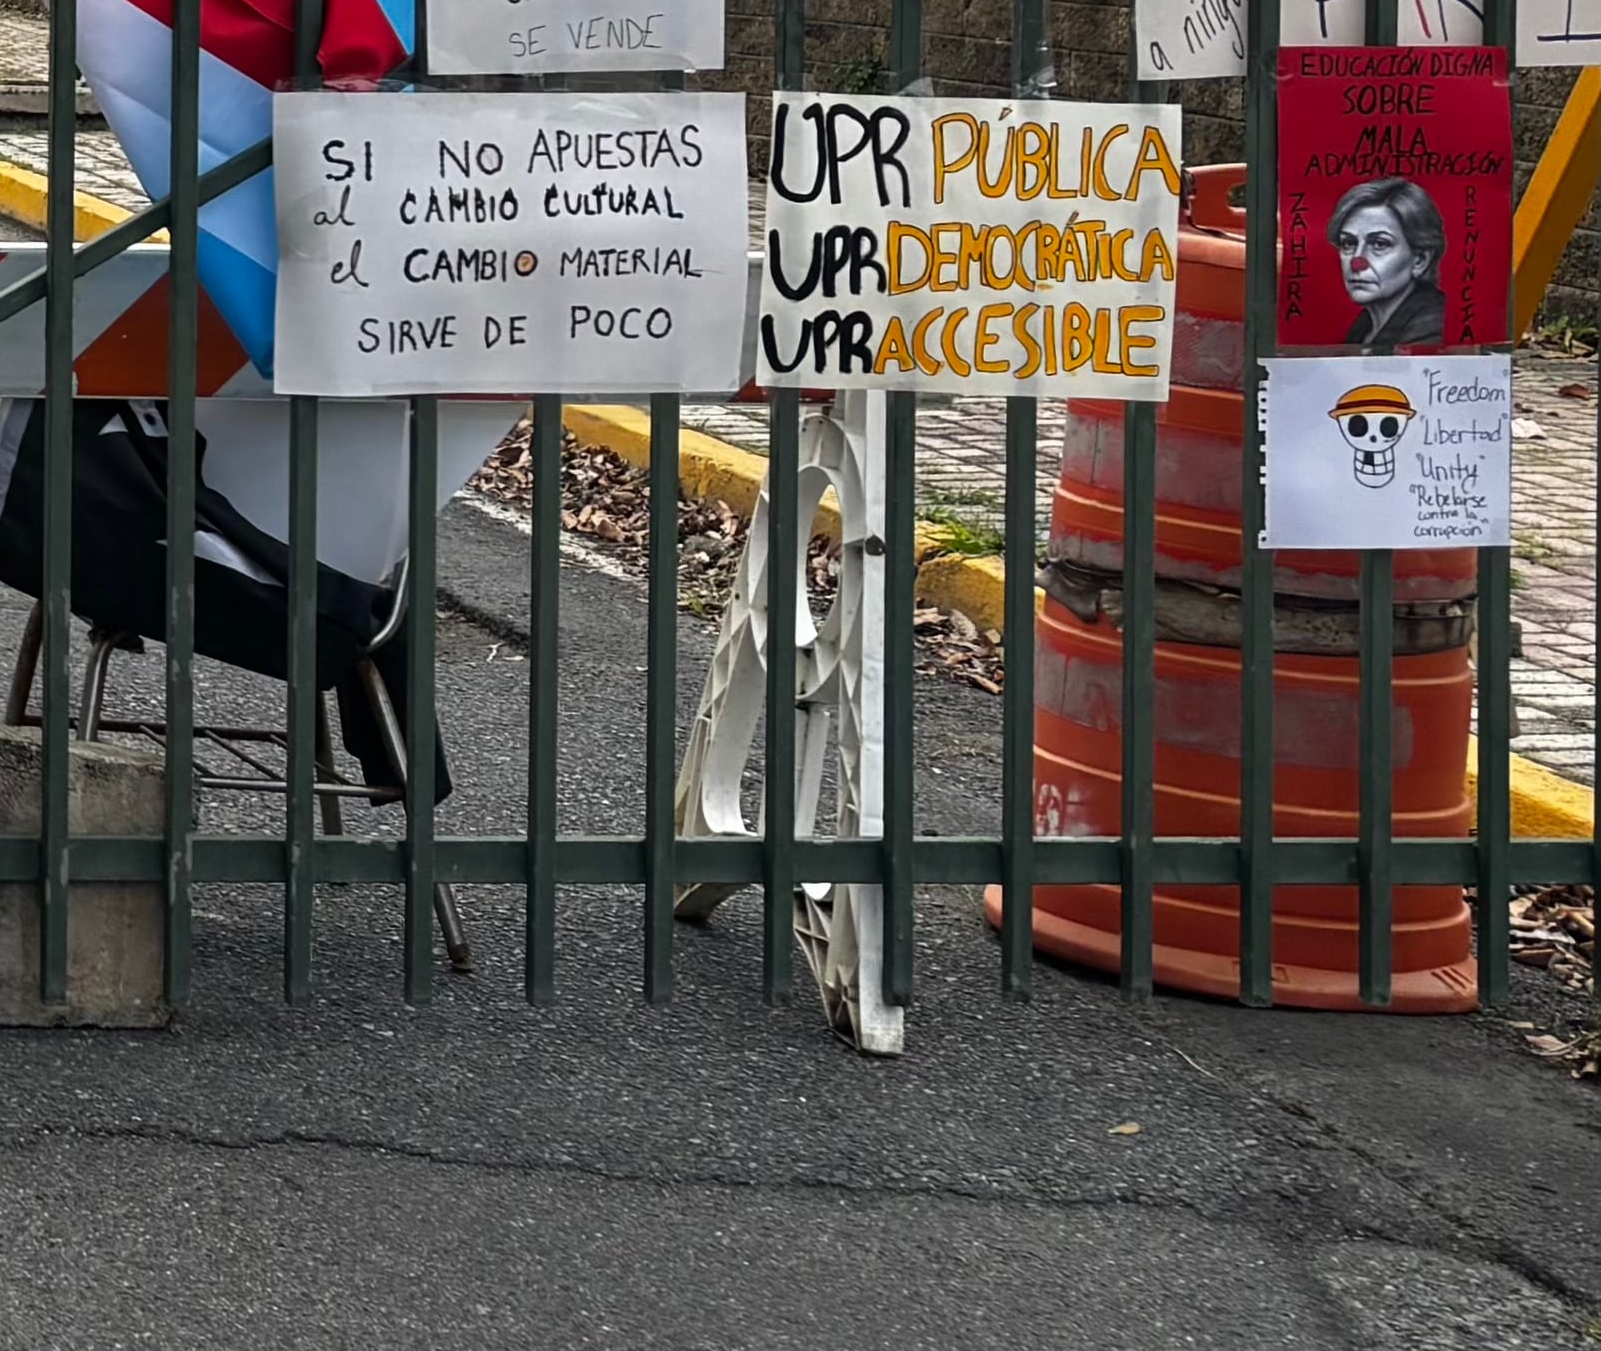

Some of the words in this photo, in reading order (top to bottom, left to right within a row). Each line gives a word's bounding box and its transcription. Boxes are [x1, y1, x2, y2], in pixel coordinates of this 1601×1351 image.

[509, 24, 546, 57] SE
[567, 13, 665, 50] VENDE
[1301, 48, 1423, 77] EDUCACIÓN
[1430, 53, 1494, 77] DIGNA
[1342, 83, 1436, 116] SOBRE
[323, 140, 372, 182] SI
[439, 140, 504, 179] NO
[527, 125, 703, 173] APUESTAS
[771, 103, 912, 208] UPR
[932, 105, 1181, 204] PÚBLICA
[1356, 125, 1428, 155] MALA
[1304, 152, 1504, 178] ADMINISTRACIÓN
[313, 185, 356, 227] al
[400, 186, 519, 225] CAMBIO
[544, 183, 684, 220] CULTURAL
[330, 240, 370, 288] el
[403, 248, 539, 283] CAMBIO
[559, 247, 703, 280] MATERIAL
[769, 225, 887, 301] UPR
[886, 210, 1174, 296] DEMOCRÁTICA
[1459, 185, 1481, 343] RENUNCIA
[358, 316, 457, 355] SIRVE
[484, 315, 527, 348] DE
[570, 306, 673, 340] POCO
[761, 310, 873, 374] UPR
[873, 301, 1165, 379] ACCESIBLE
[1466, 507, 1478, 520] la
